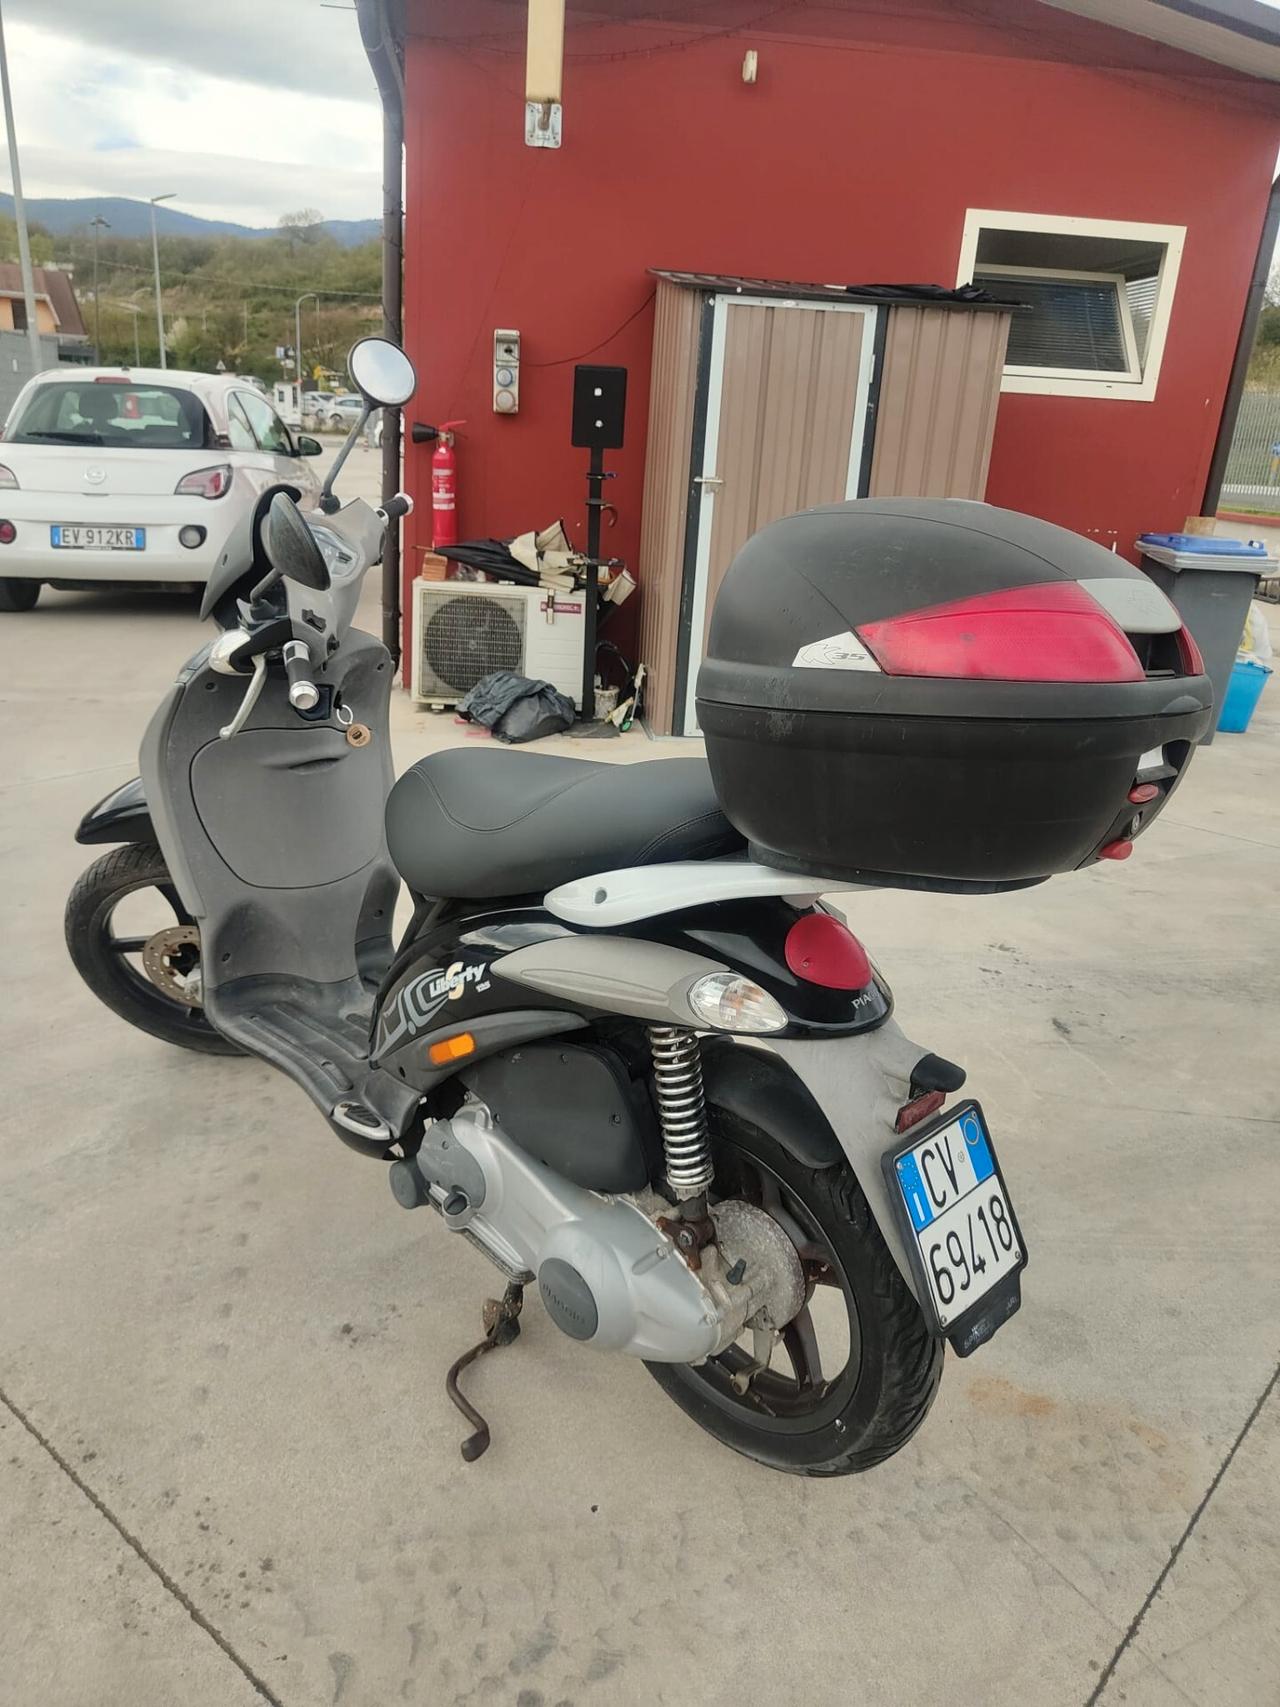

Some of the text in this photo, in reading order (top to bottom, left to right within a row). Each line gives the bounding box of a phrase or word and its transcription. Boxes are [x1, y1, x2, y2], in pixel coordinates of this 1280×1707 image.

[62, 528, 134, 546] EV 912KR
[921, 1135, 959, 1208] CV
[929, 1194, 1013, 1305] 69418
